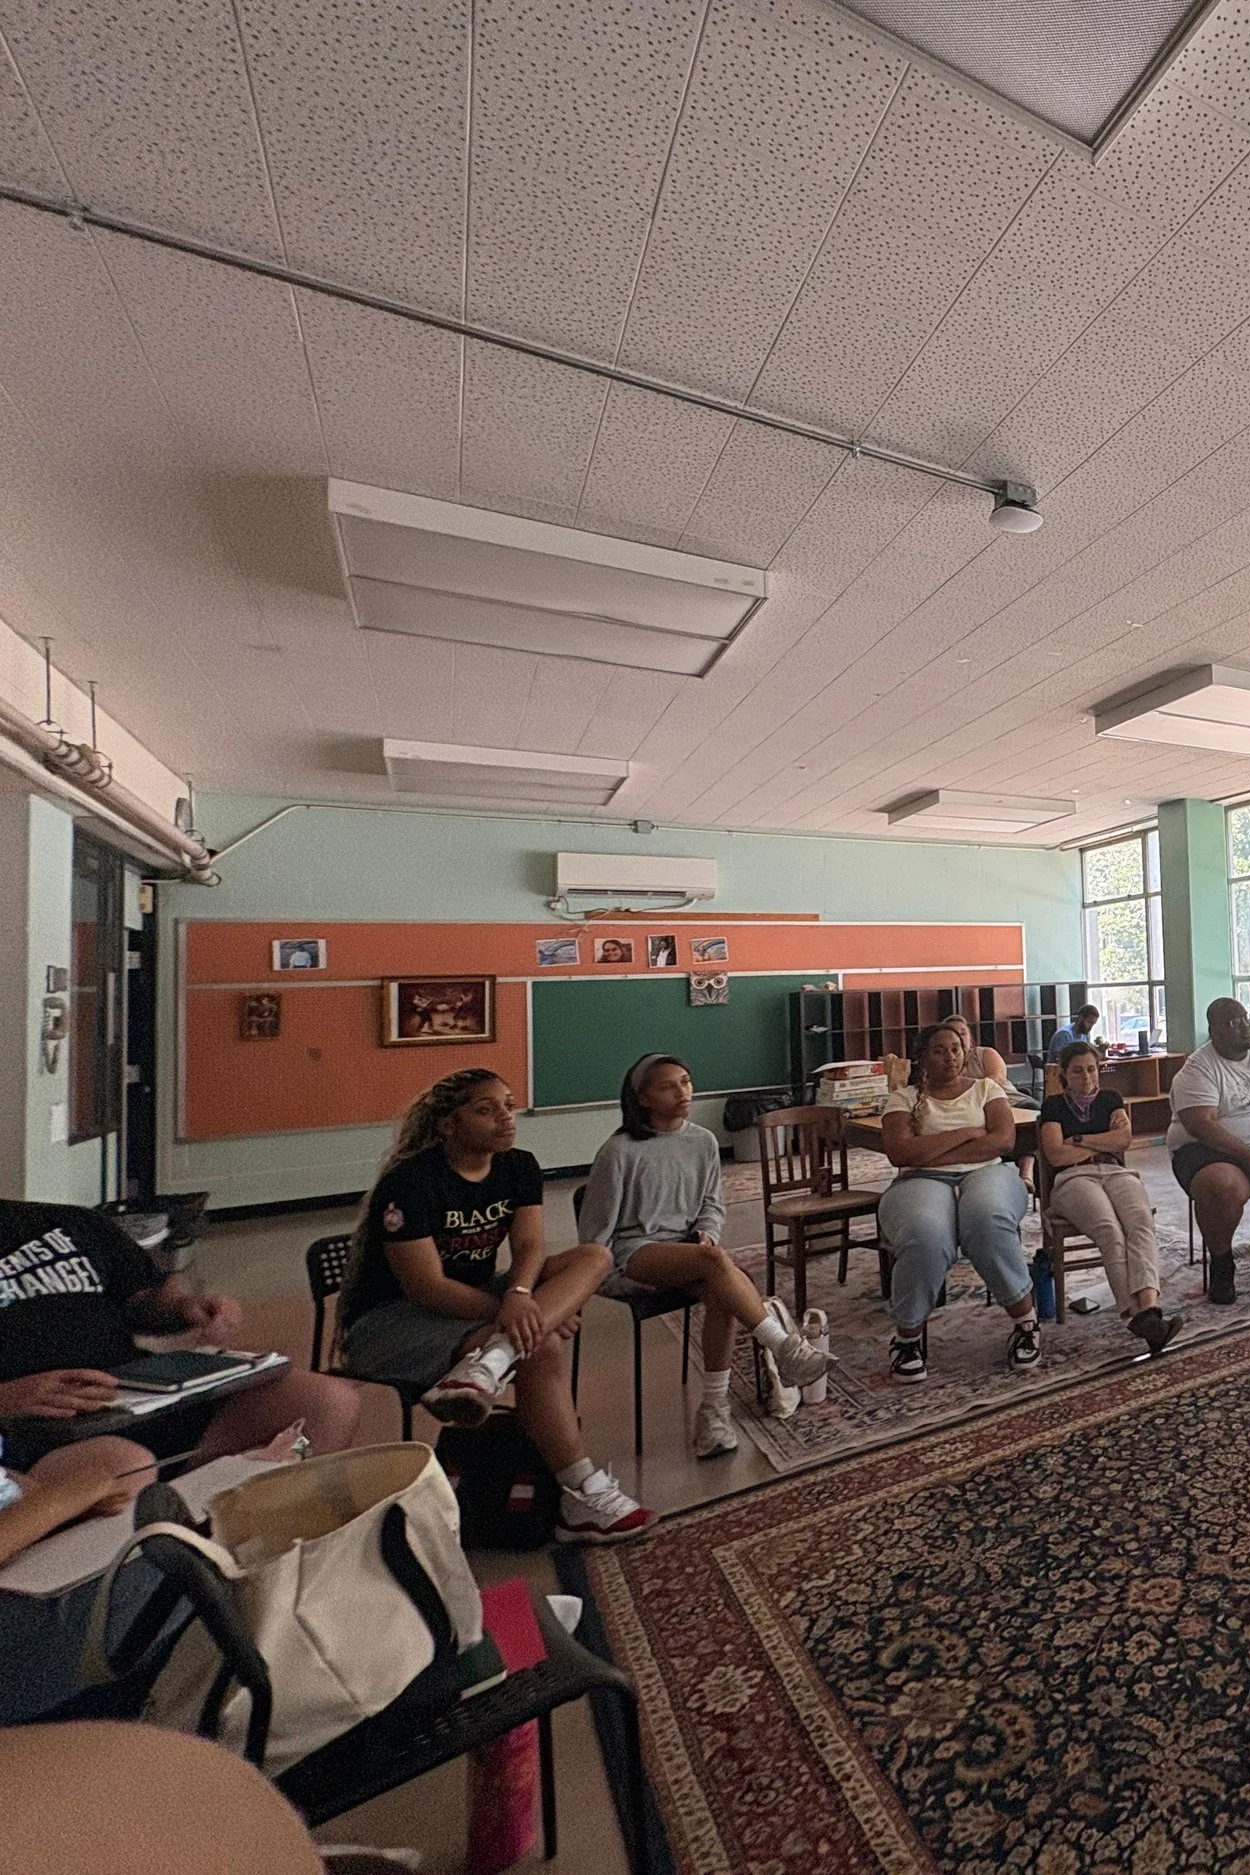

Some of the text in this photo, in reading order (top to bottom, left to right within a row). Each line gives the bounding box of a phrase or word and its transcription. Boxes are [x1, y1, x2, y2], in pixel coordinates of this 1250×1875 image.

[444, 1199, 514, 1229] BLACK
[0, 1227, 78, 1279] ENTS OF
[0, 1256, 103, 1302] HANGE!
